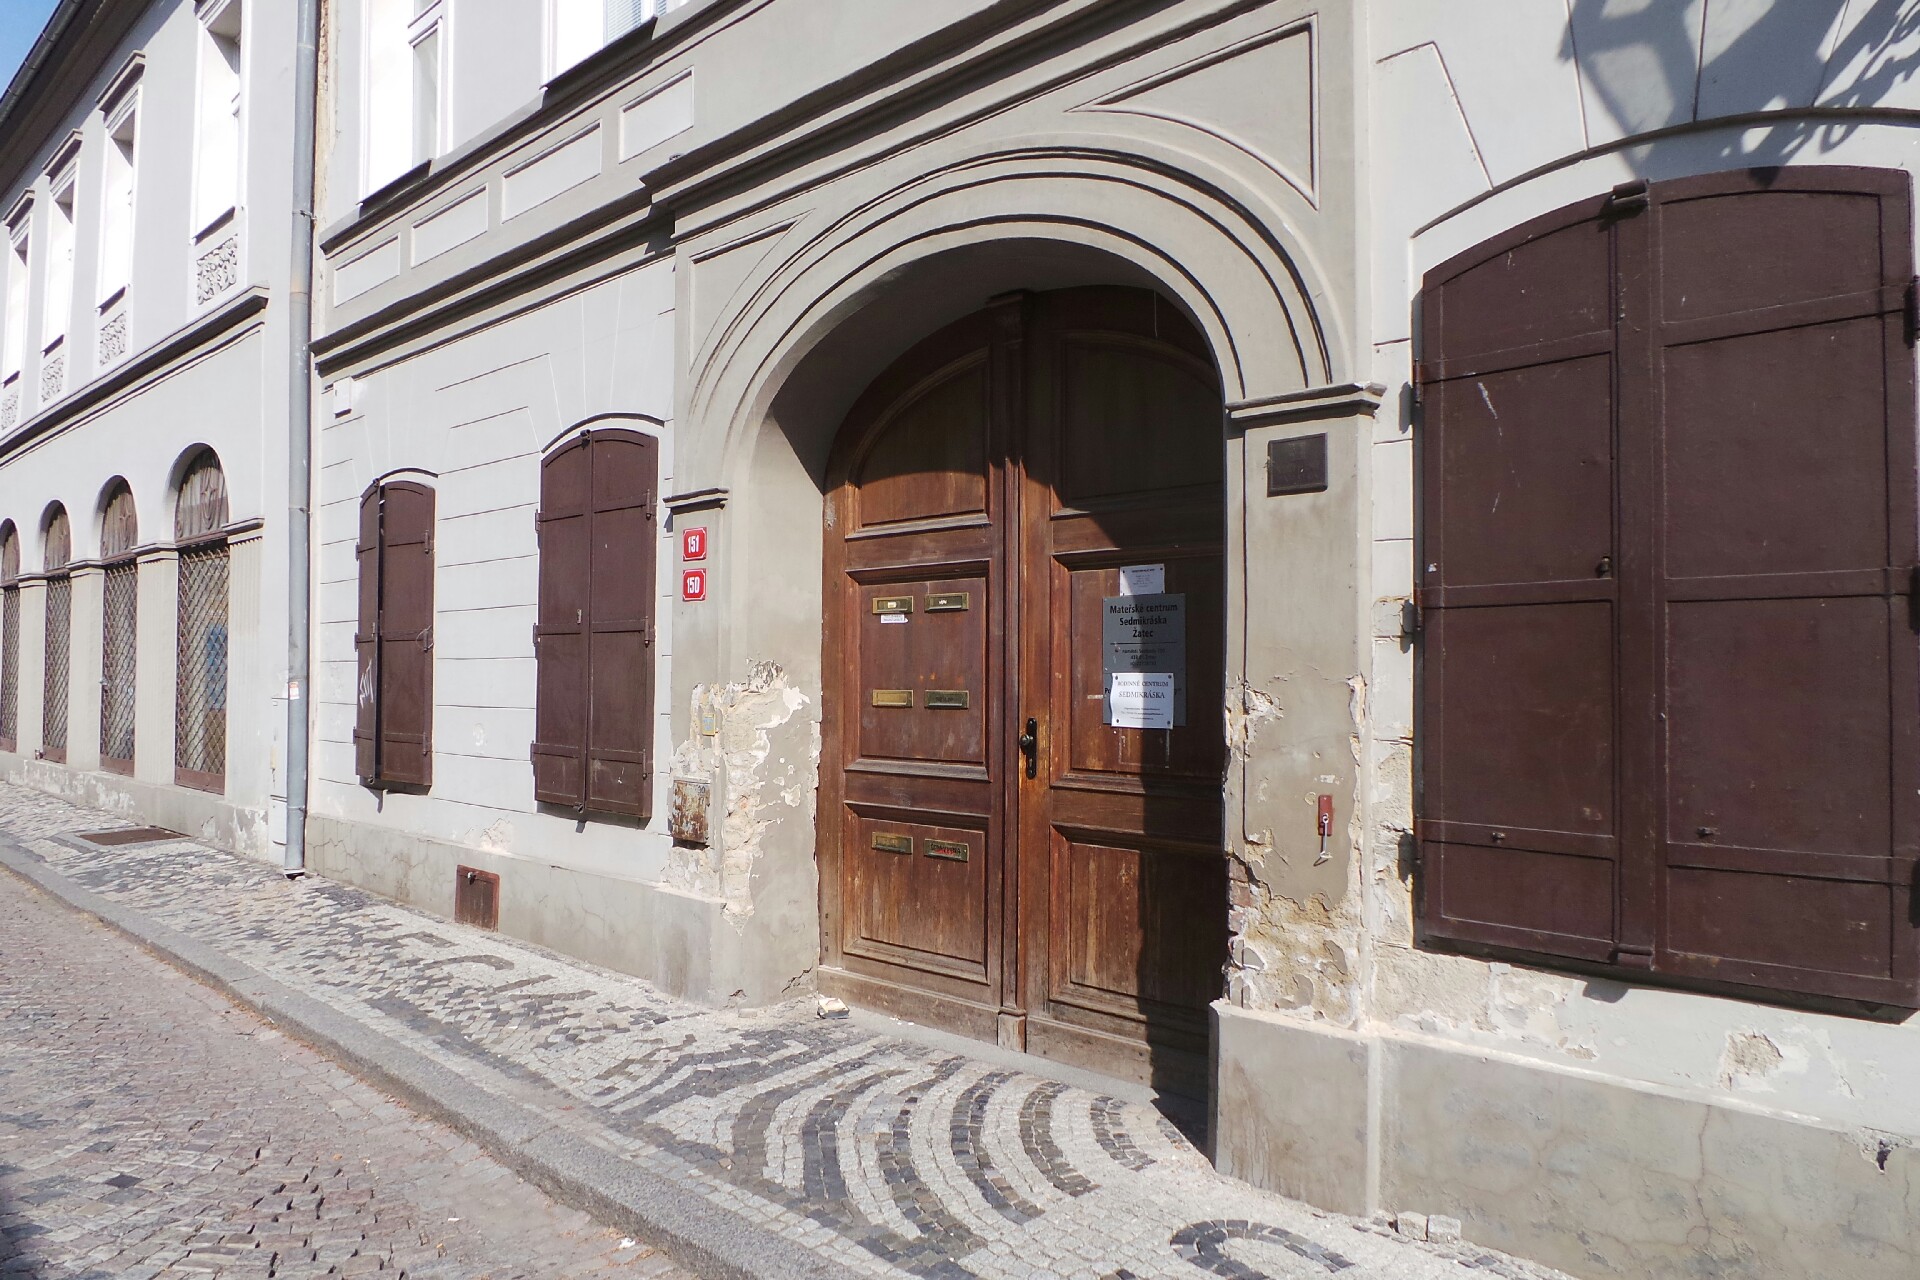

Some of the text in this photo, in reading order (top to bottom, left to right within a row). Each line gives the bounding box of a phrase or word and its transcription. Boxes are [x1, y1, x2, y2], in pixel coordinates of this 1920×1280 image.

[688, 535, 699, 553] 151
[687, 577, 700, 593] 150
[1109, 603, 1178, 614] Mateřské centrum
[1119, 615, 1167, 626] Sedmikráska
[1132, 627, 1154, 638] Žatec
[1118, 690, 1165, 699] SEDMIKRÁSKA
